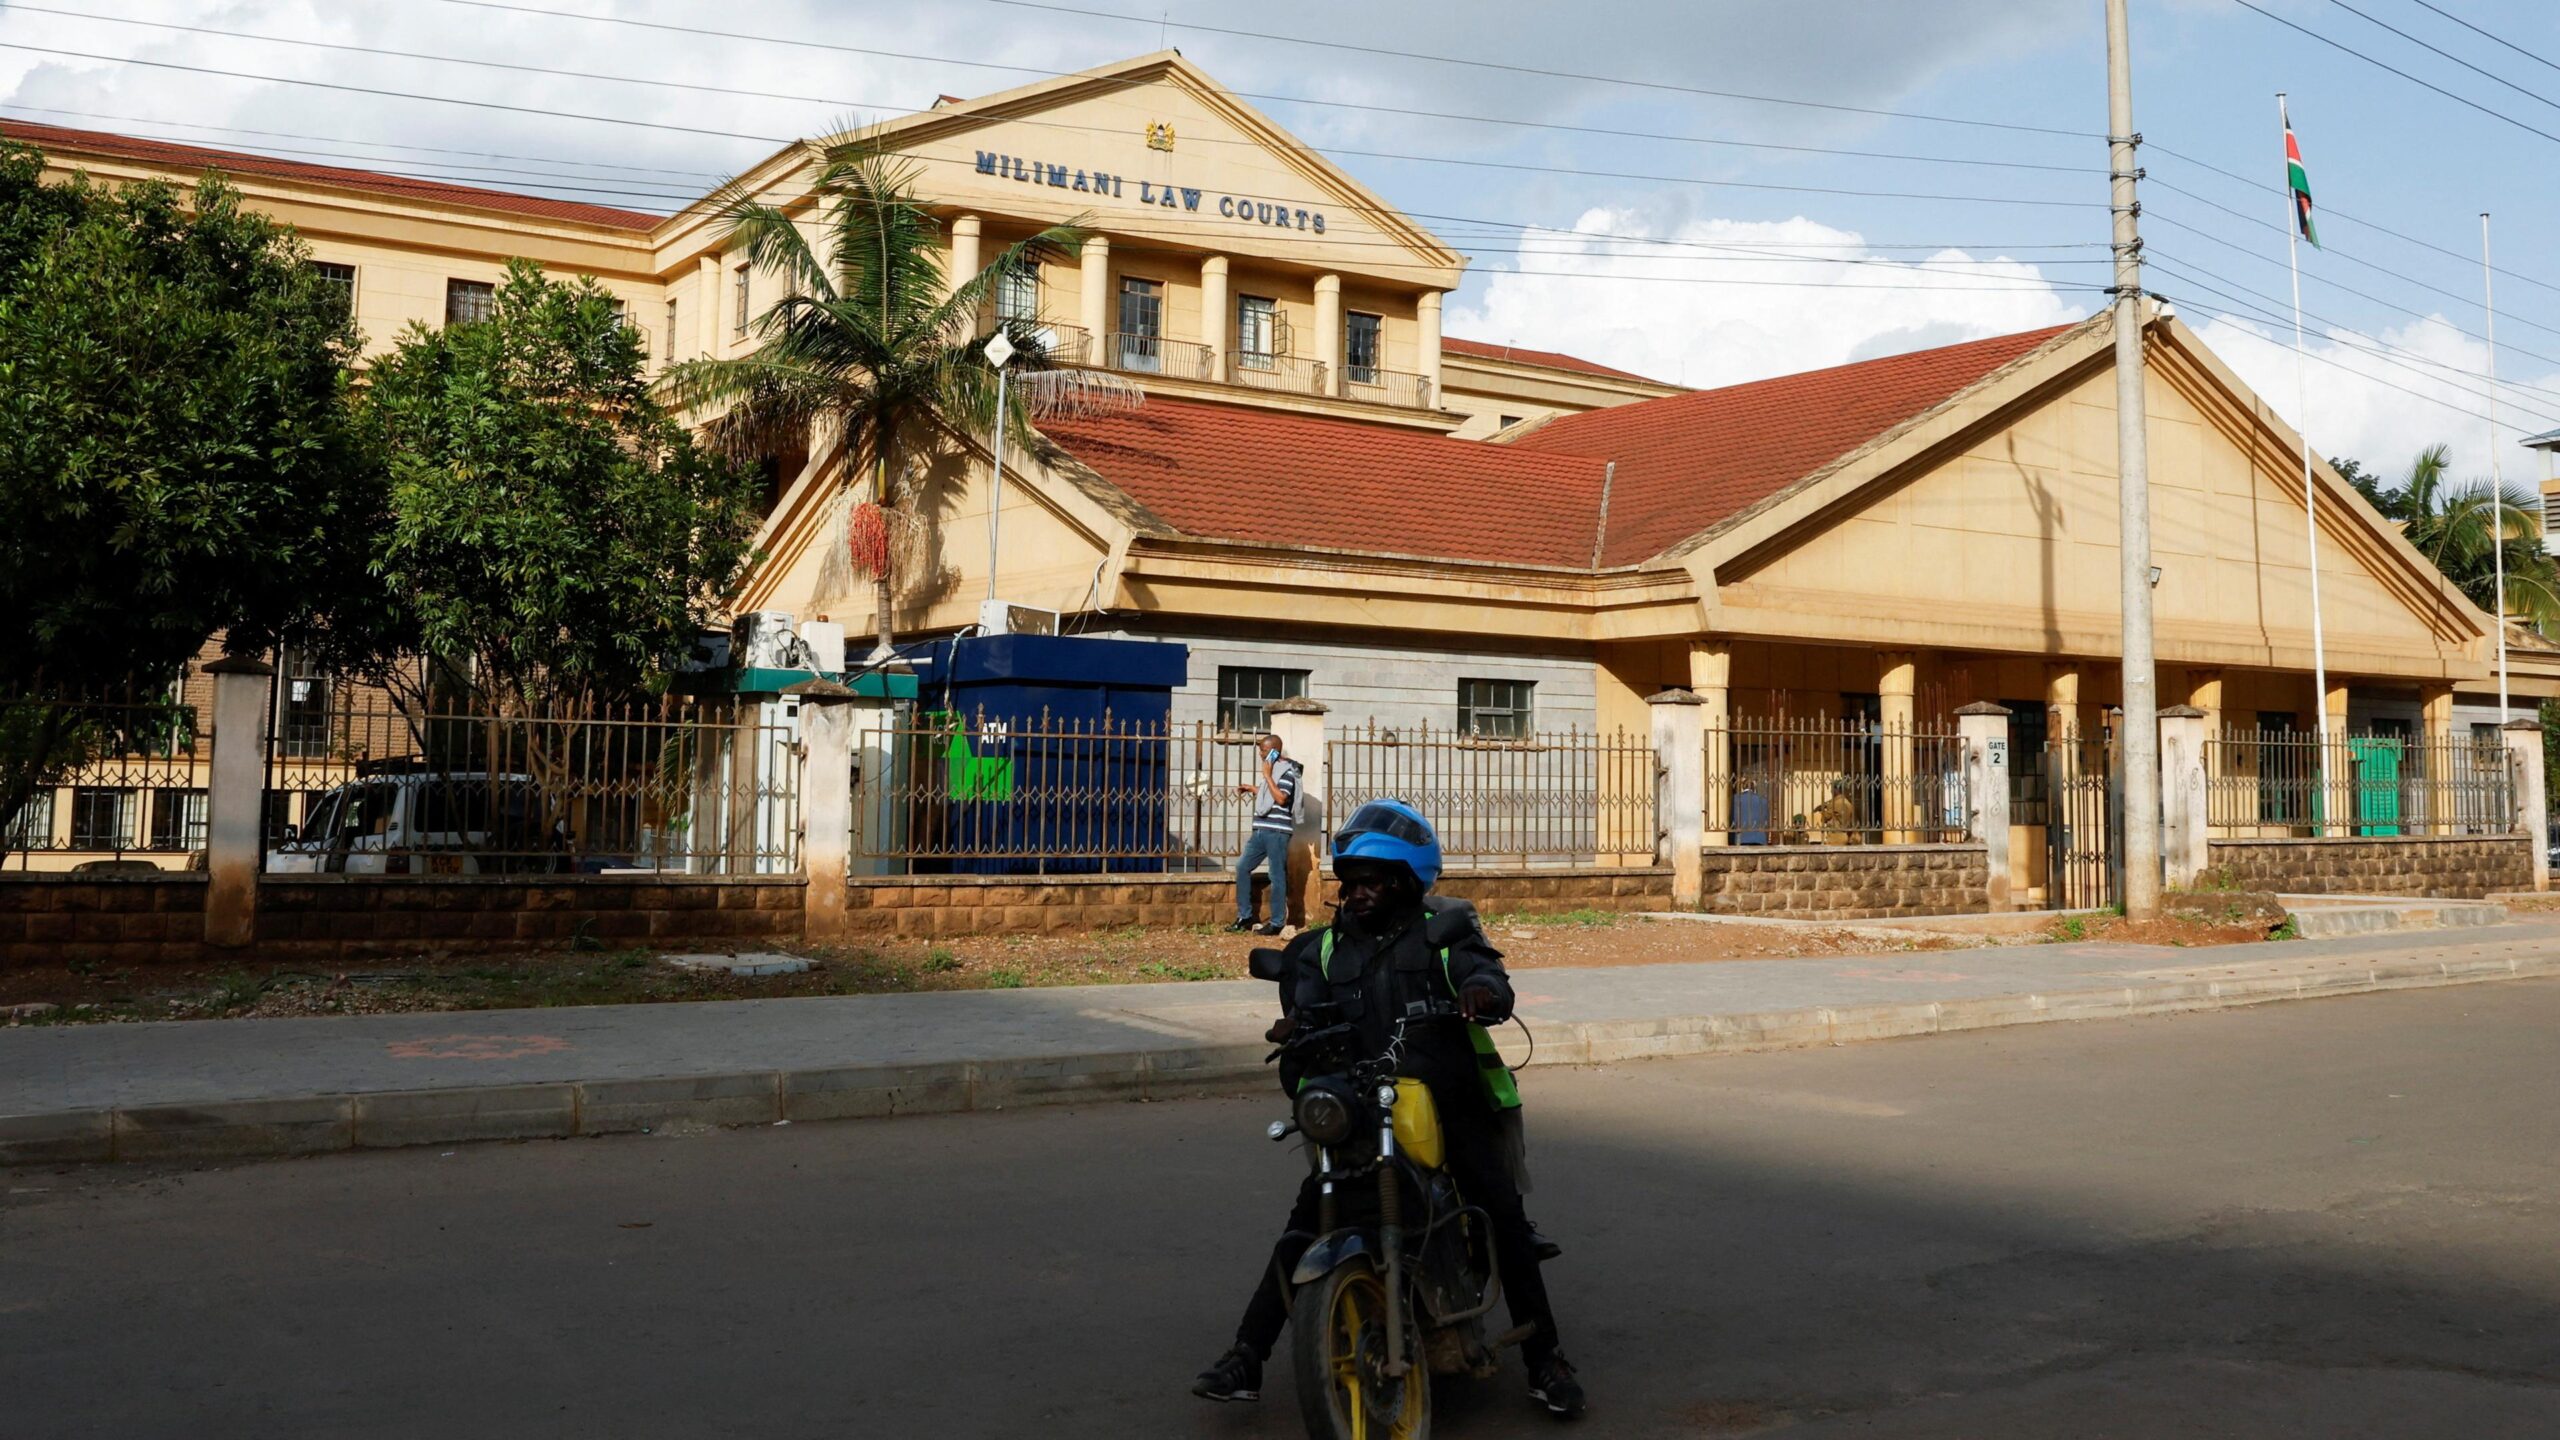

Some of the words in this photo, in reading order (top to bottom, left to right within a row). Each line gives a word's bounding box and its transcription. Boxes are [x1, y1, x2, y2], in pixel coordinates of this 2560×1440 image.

[975, 150, 1122, 198] MILIMANI
[1139, 180, 1202, 212] LAW
[1218, 196, 1326, 234] COURTS
[981, 722, 1007, 744] ATM
[1988, 742, 2006, 750] GATE
[1993, 752, 2001, 764] 2
